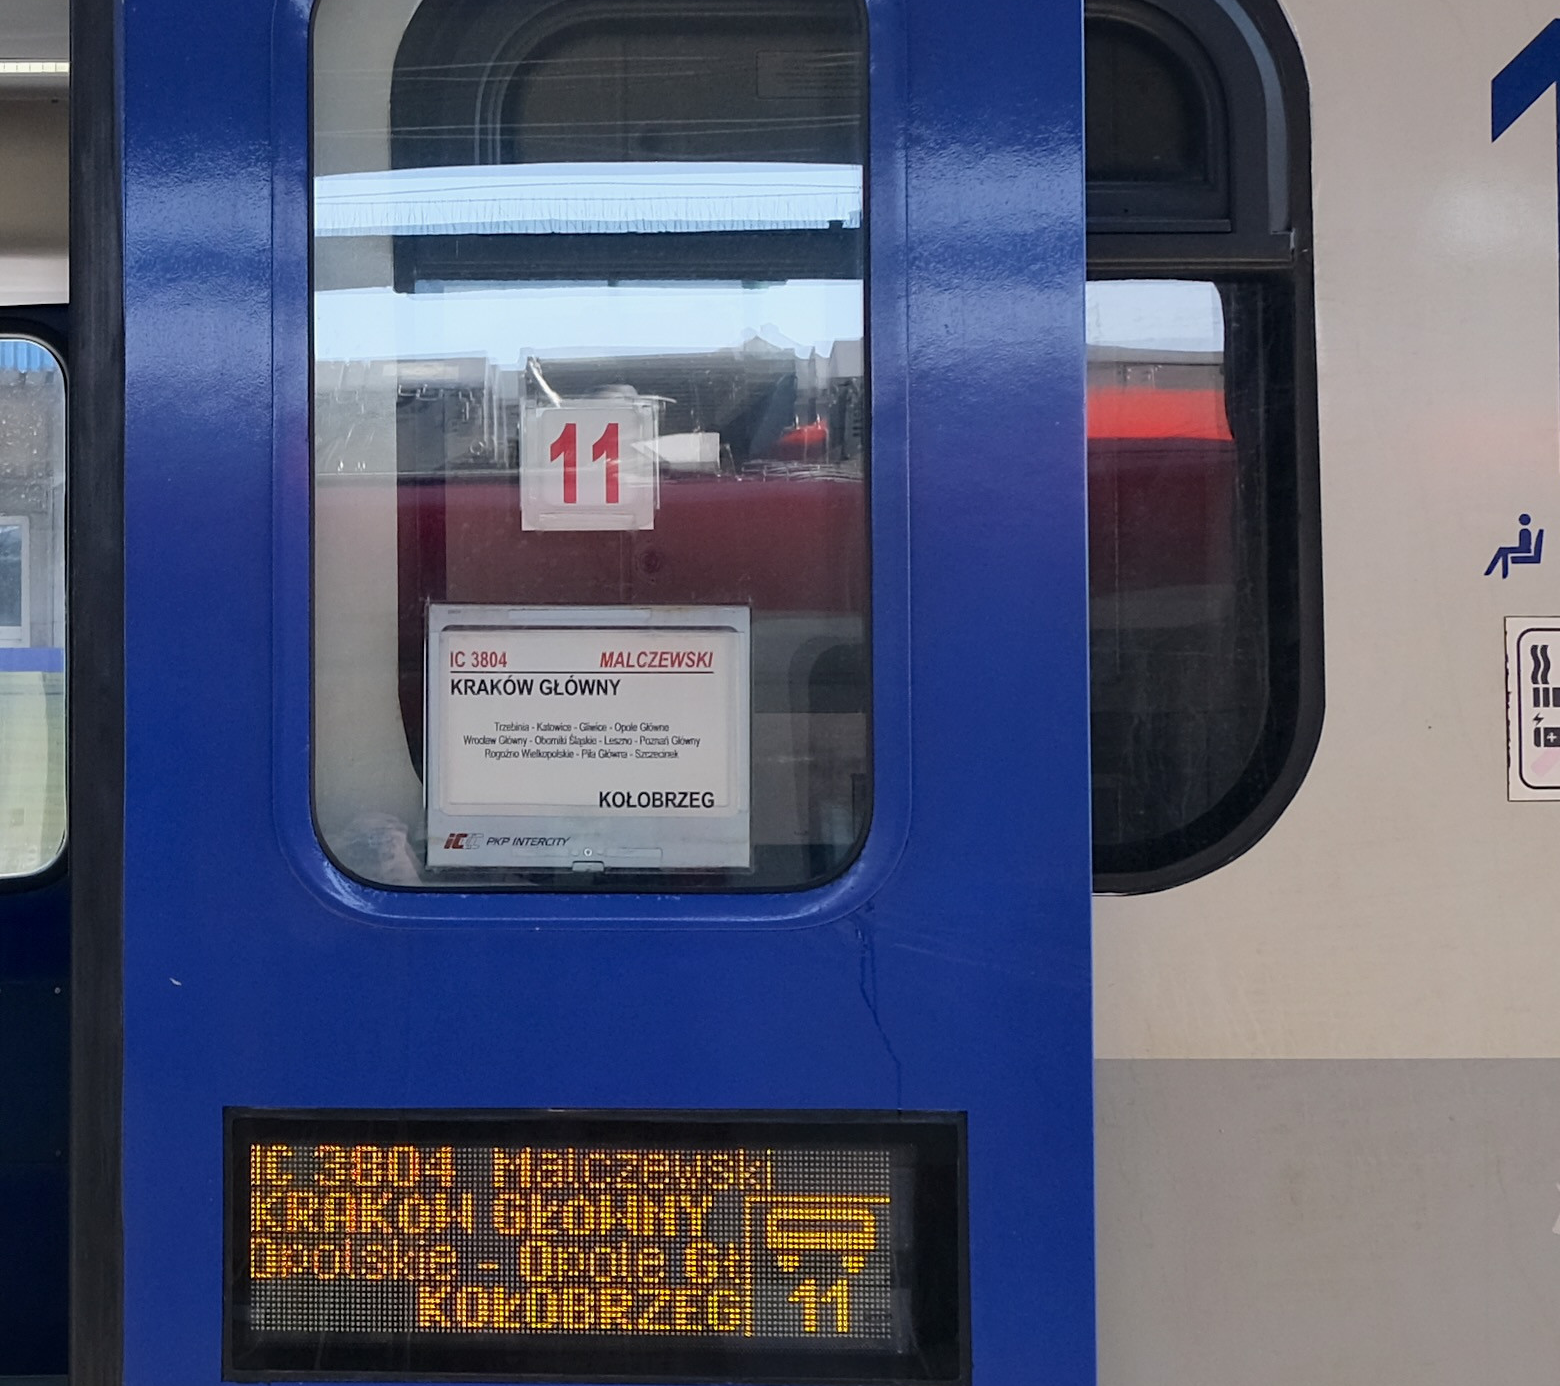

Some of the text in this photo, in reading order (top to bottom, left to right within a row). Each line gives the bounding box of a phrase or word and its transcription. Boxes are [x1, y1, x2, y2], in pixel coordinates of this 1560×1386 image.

[549, 422, 620, 505] 11
[450, 651, 508, 668] IC 3804
[600, 651, 714, 668] MALCZEWSKI
[451, 674, 620, 696] KRAKÓW GŁÓWNY
[536, 722, 572, 732] Katowice
[614, 722, 638, 734] Opole
[639, 722, 670, 732] Główne
[498, 734, 528, 748] Główny
[671, 734, 701, 748] Główny
[599, 791, 715, 809] KOŁOBRZEG
[486, 836, 510, 846] PKP
[512, 836, 572, 847] INTERCITY
[250, 1144, 773, 1192] IC 3804 Malczewski
[519, 1239, 665, 1282] Opole
[418, 1277, 851, 1334] KOŁOBRZEG 11
